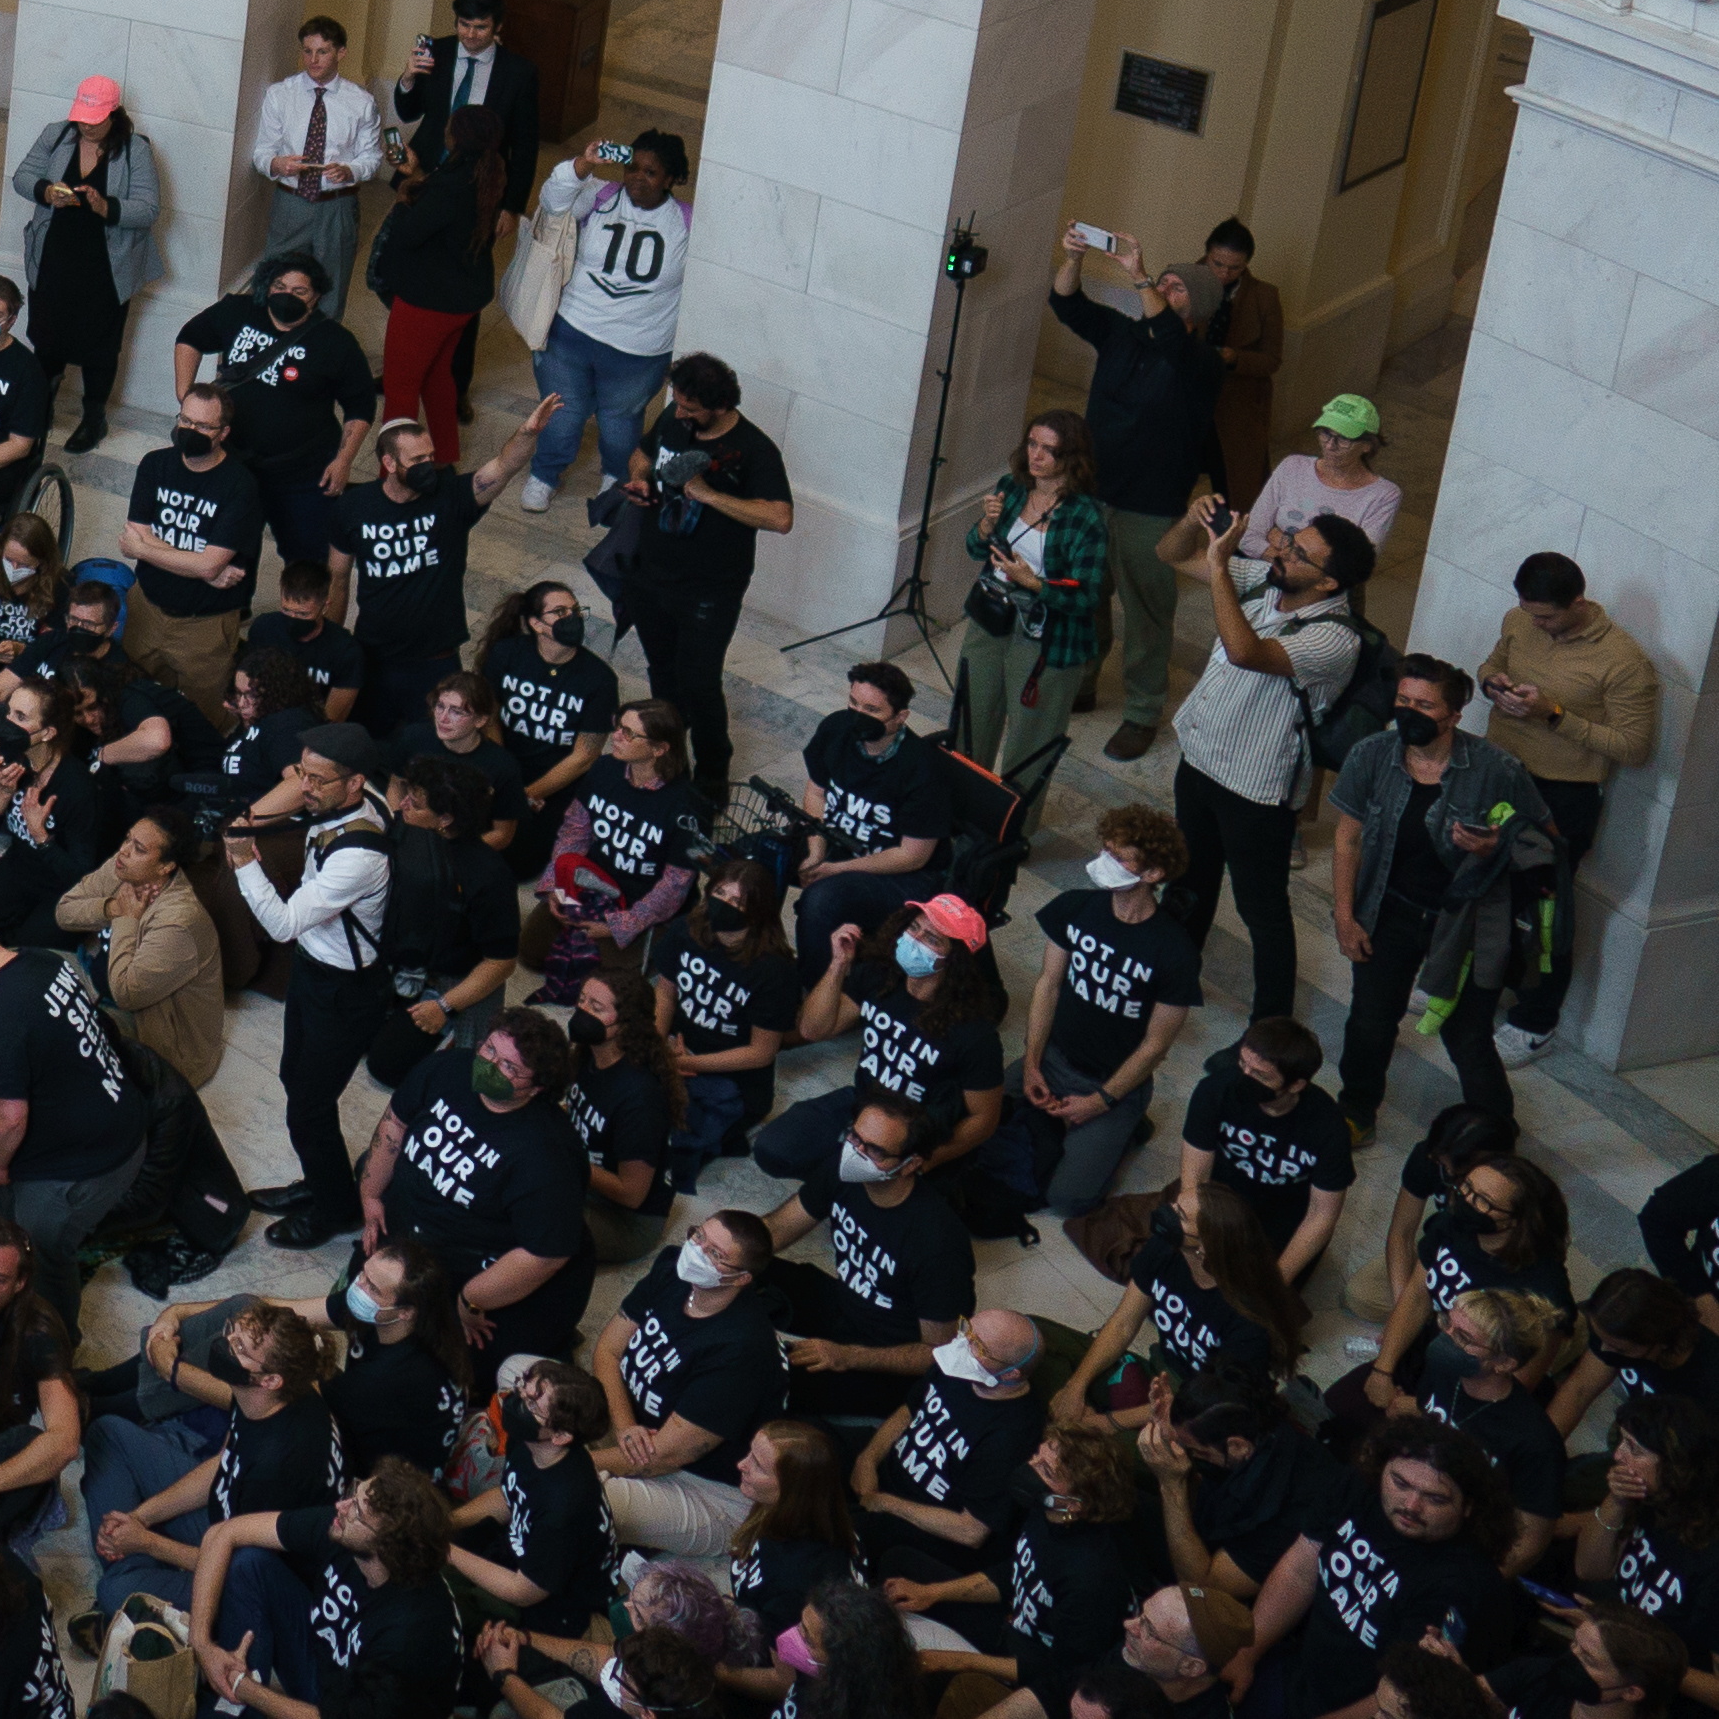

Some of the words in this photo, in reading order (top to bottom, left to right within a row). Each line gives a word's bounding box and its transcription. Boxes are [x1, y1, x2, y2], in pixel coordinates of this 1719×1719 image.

[602, 223, 664, 284] 10
[234, 337, 253, 351] UP
[157, 487, 194, 509] NOT
[198, 499, 217, 517] IN
[160, 508, 201, 532] OUR
[363, 522, 406, 541] NOT
[414, 514, 436, 533] IN
[373, 532, 427, 560] OUR
[366, 549, 439, 578] NAME
[502, 675, 550, 703] NOT
[557, 691, 584, 713] IN
[507, 697, 567, 729] OUR
[588, 794, 635, 823] NOT
[640, 820, 663, 845] IN
[593, 819, 647, 860] OUR
[1067, 924, 1115, 962] NOT
[1122, 953, 1152, 982] IN
[1071, 951, 1131, 996] OUR
[677, 971, 731, 1019] OUR
[726, 985, 750, 1005] IN
[862, 1001, 906, 1039] NOT
[910, 1035, 940, 1065] IN
[864, 1026, 916, 1076] OUR
[430, 1099, 475, 1142] NOT
[475, 1143, 500, 1169] IN
[584, 1109, 605, 1132] IN
[423, 1125, 476, 1180] OUR
[1287, 1145, 1317, 1166] IN
[831, 1202, 868, 1242] NOT
[872, 1245, 896, 1276] IN
[833, 1229, 878, 1284] OUR
[662, 1343, 681, 1372] IN
[946, 1426, 969, 1461] IN
[1337, 1520, 1384, 1572] NOT
[1330, 1551, 1378, 1612] OUR
